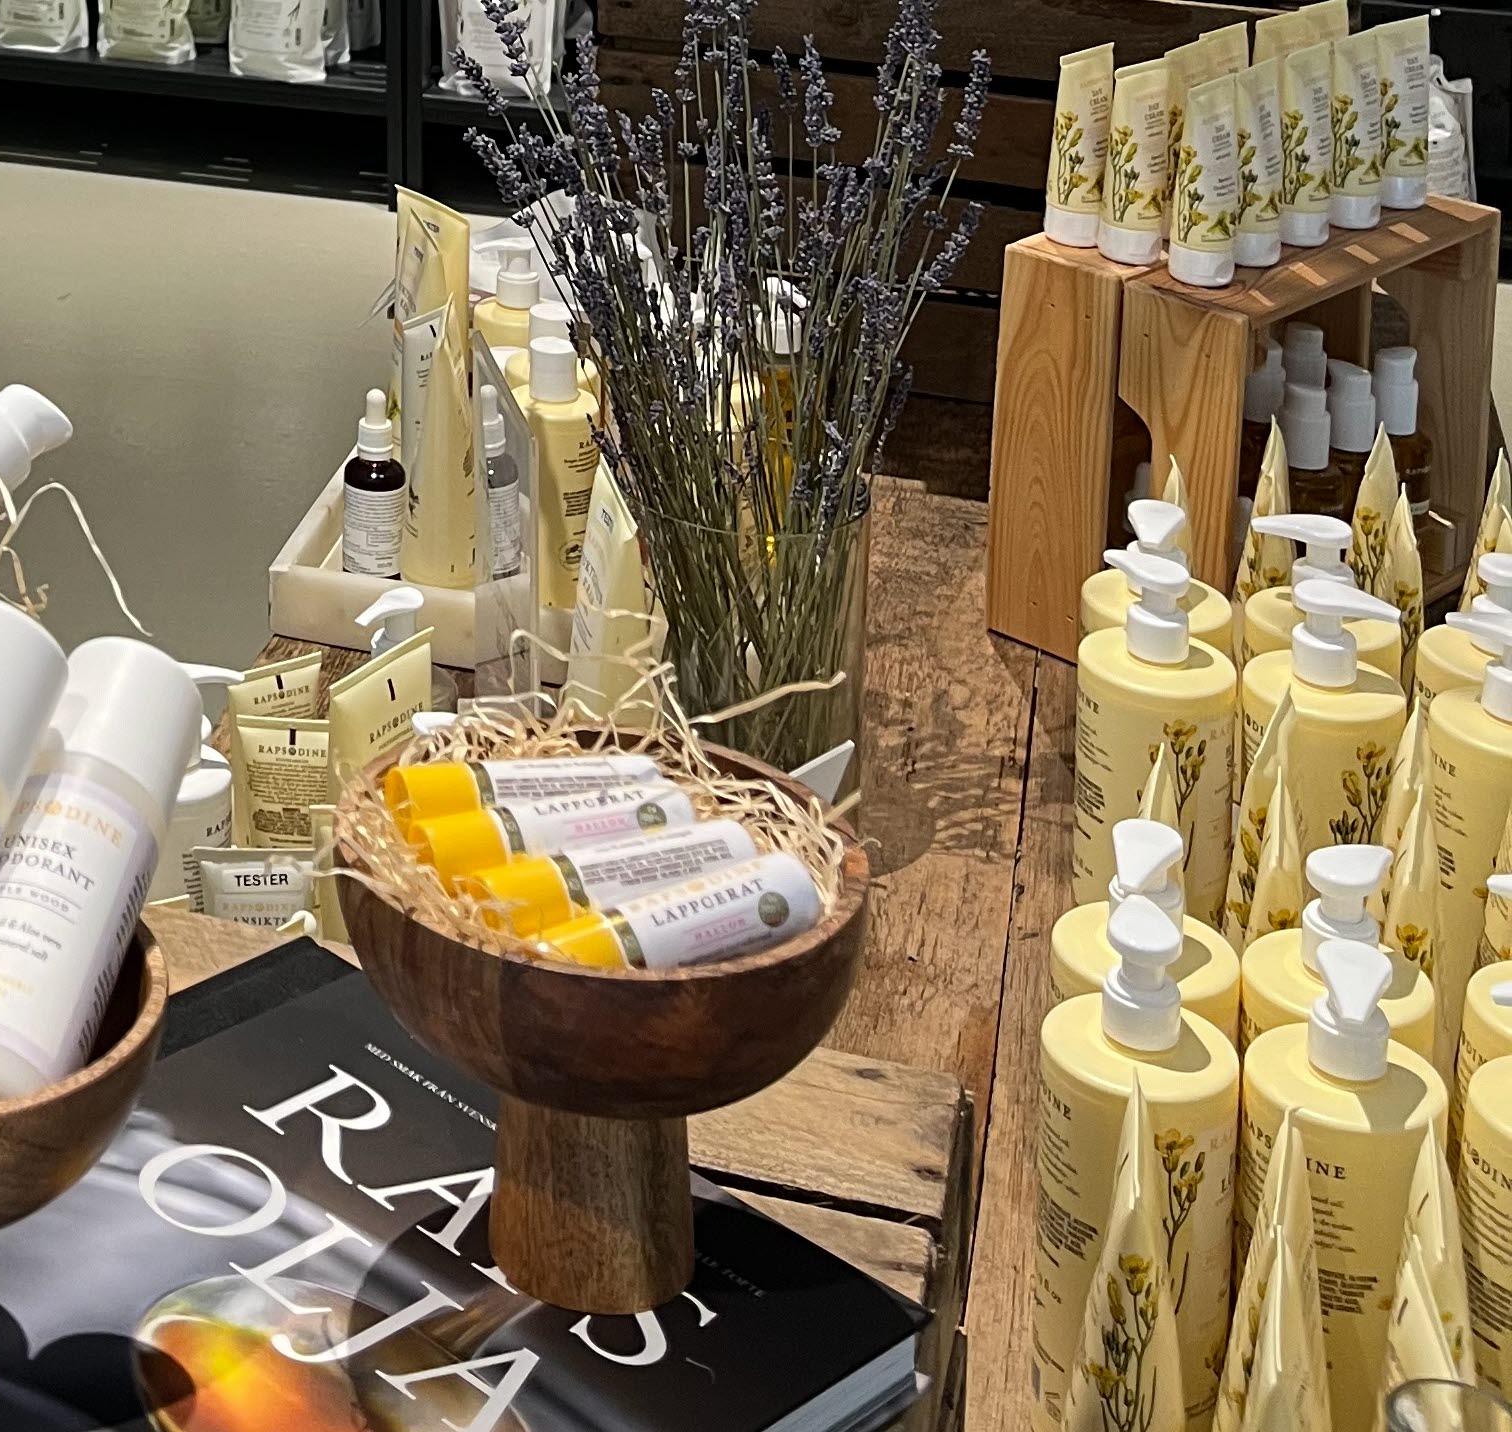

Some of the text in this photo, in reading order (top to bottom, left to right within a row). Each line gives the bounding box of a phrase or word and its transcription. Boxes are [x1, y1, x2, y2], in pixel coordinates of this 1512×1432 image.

[253, 685, 311, 706] RAPSODINE
[368, 701, 424, 744] RAPSODINE
[258, 744, 327, 758] RAPSODINE
[4, 832, 79, 860] UNISEX
[234, 873, 289, 888] TESTER
[242, 1063, 718, 1368] RAS
[138, 1143, 541, 1432] OLJA
